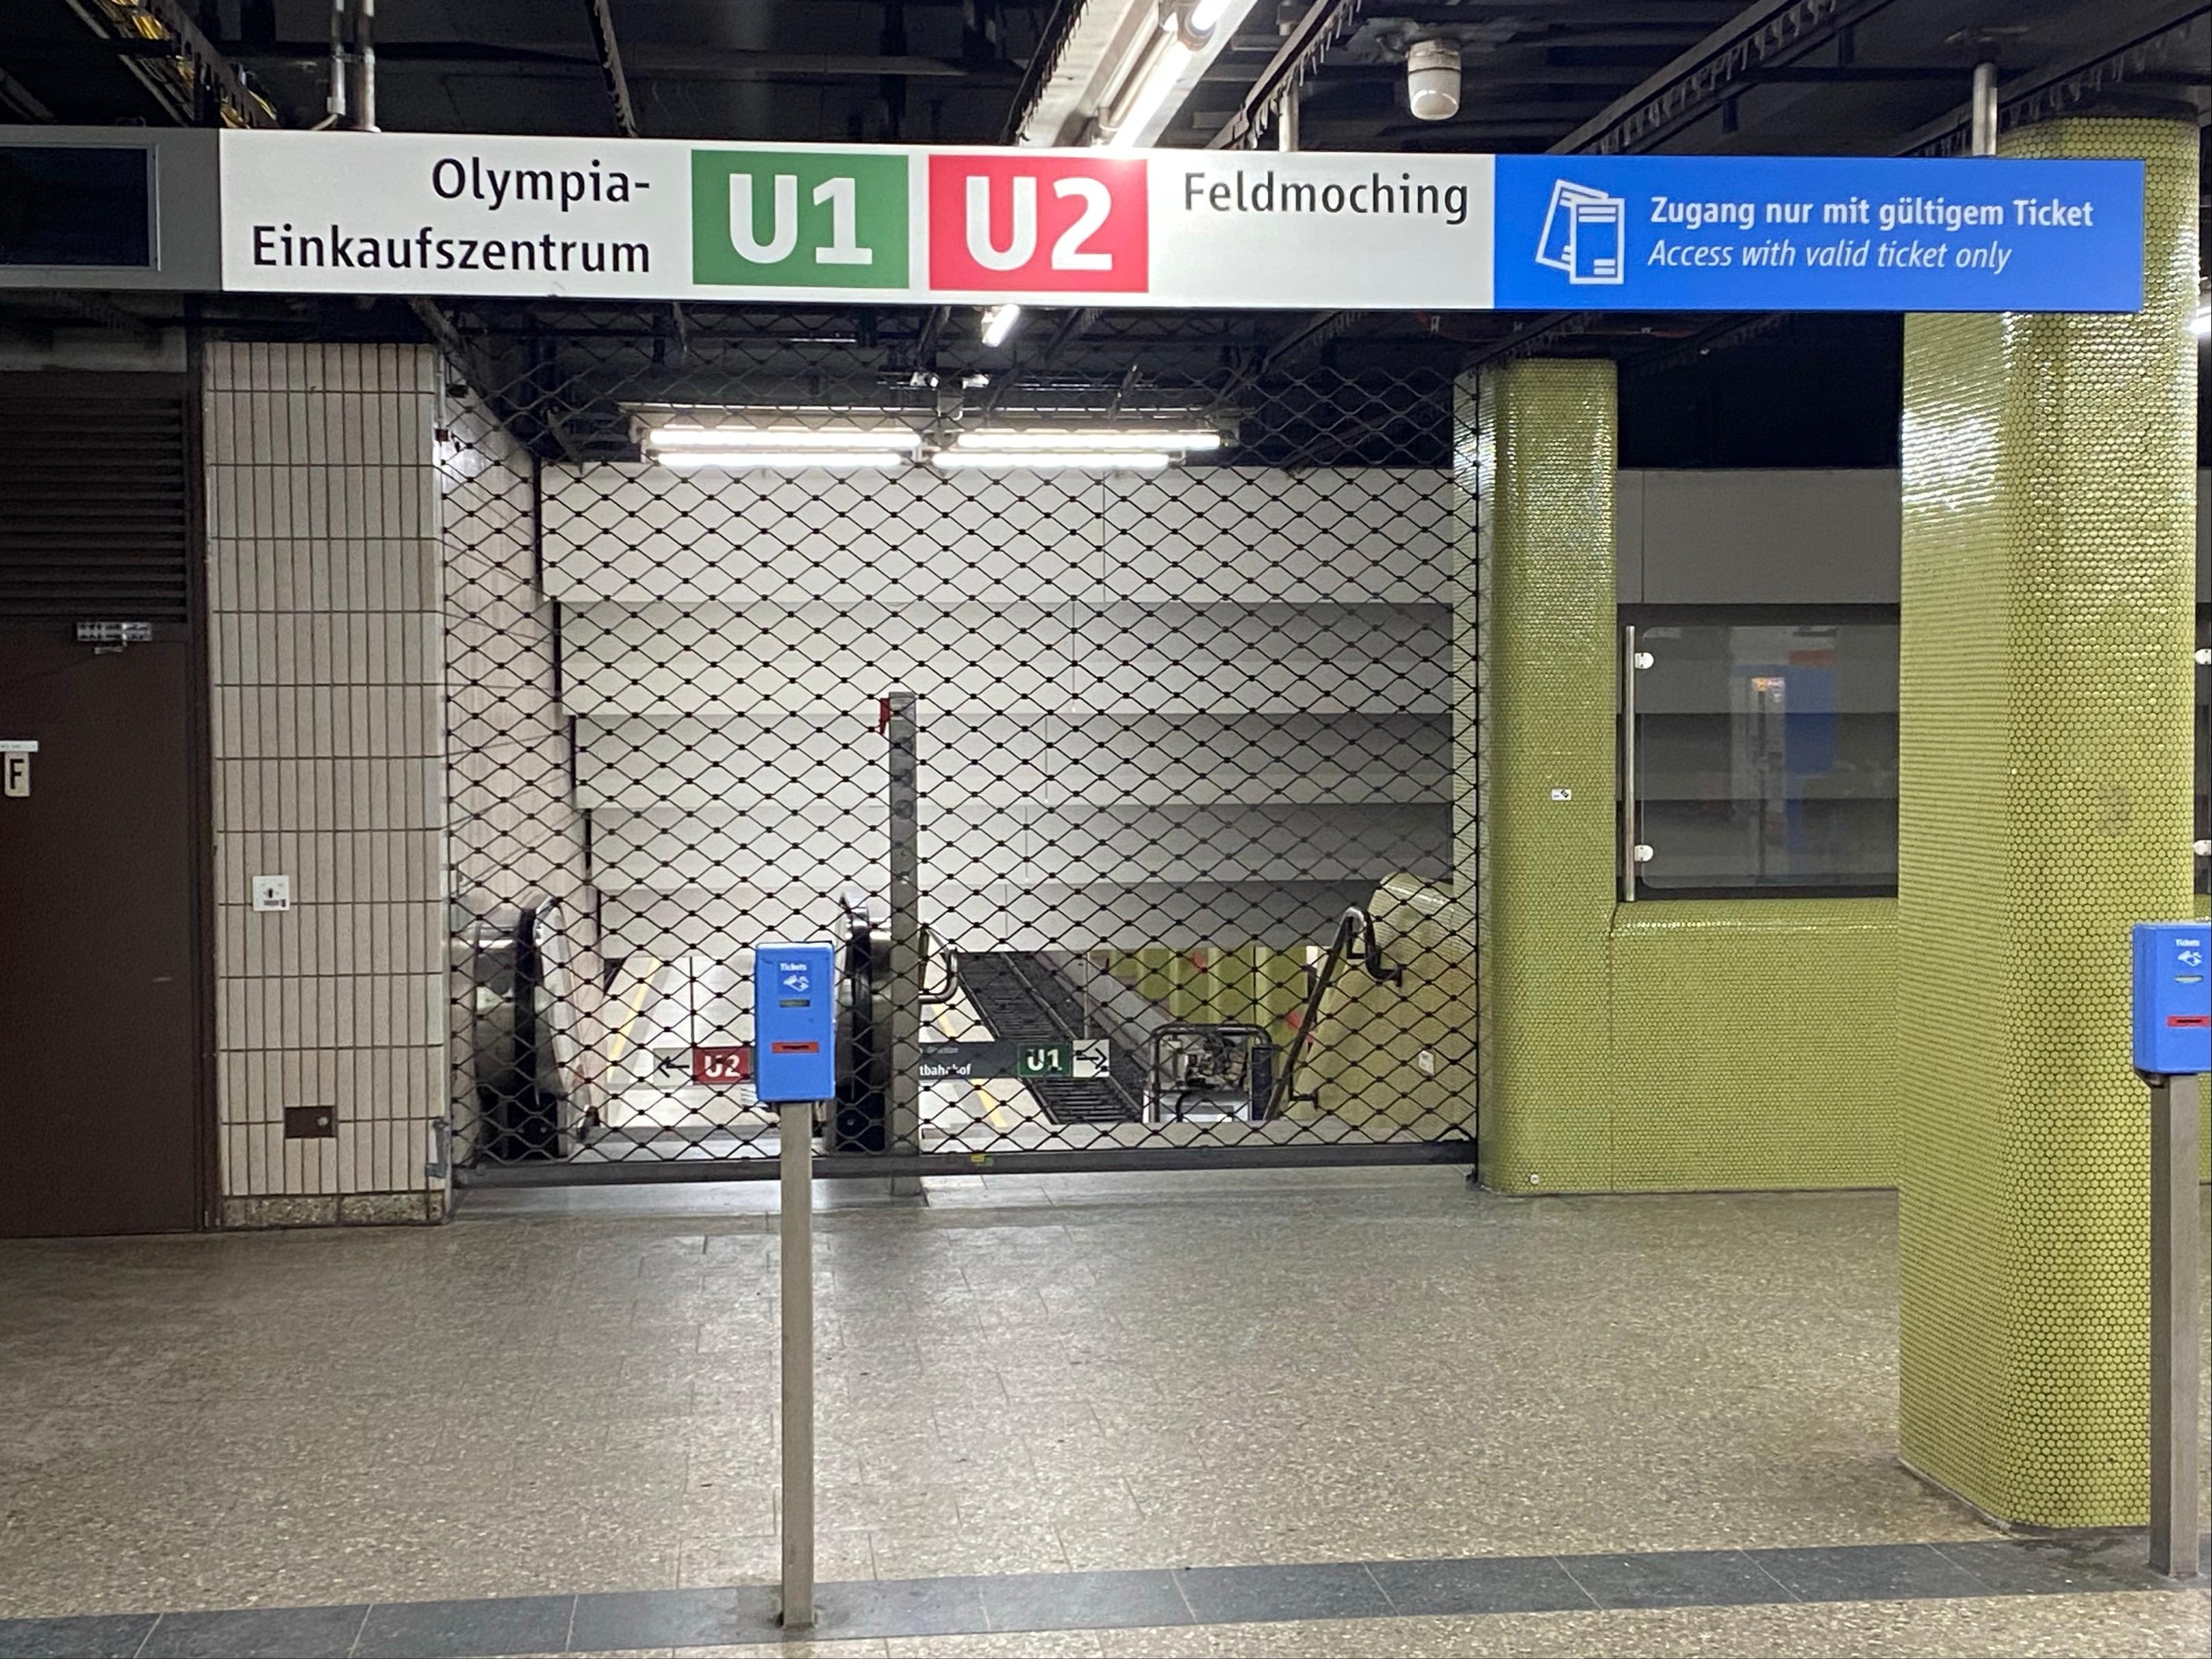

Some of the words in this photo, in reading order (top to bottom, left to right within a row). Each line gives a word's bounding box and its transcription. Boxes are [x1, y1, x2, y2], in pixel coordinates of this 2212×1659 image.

[432, 156, 650, 212] Olympia-
[1186, 170, 1467, 225] Feldmoching
[729, 173, 873, 264] U1
[966, 175, 1113, 271] U2
[1651, 197, 1755, 229] Zugang
[1766, 203, 1813, 223] nur
[1824, 197, 1870, 224] mit
[1879, 197, 2003, 231] gültigem
[2013, 199, 2094, 226] Ticket
[253, 223, 649, 273] Einkaufszentrum
[1647, 240, 1733, 266] Access
[1742, 239, 1796, 266] with
[1806, 240, 1870, 266] valid
[1878, 240, 1948, 267] ticket
[1955, 240, 2012, 275] only
[10, 758, 24, 789] F
[2175, 939, 2200, 947] Tickets
[780, 963, 807, 971] Tickets
[704, 1054, 741, 1078] U2
[1027, 1048, 1063, 1072] U1
